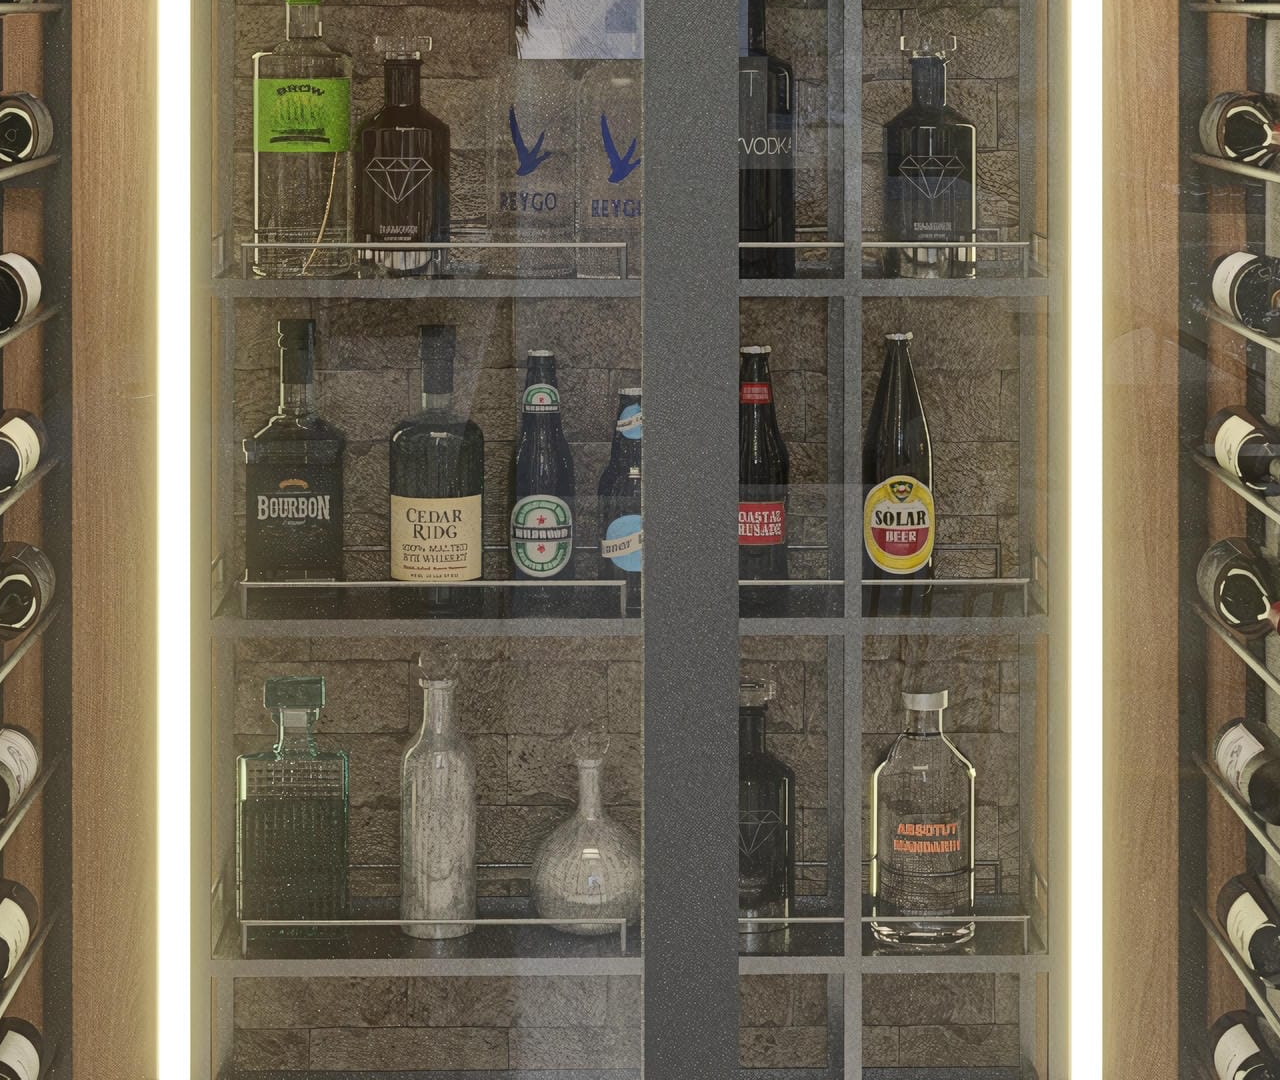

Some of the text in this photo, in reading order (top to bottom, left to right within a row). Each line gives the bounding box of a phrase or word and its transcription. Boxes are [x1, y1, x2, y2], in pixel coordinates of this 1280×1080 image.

[257, 495, 330, 520] BOURBON
[406, 507, 462, 524] CEDAR
[875, 510, 927, 527] SOLAR
[413, 523, 457, 540] RIDG
